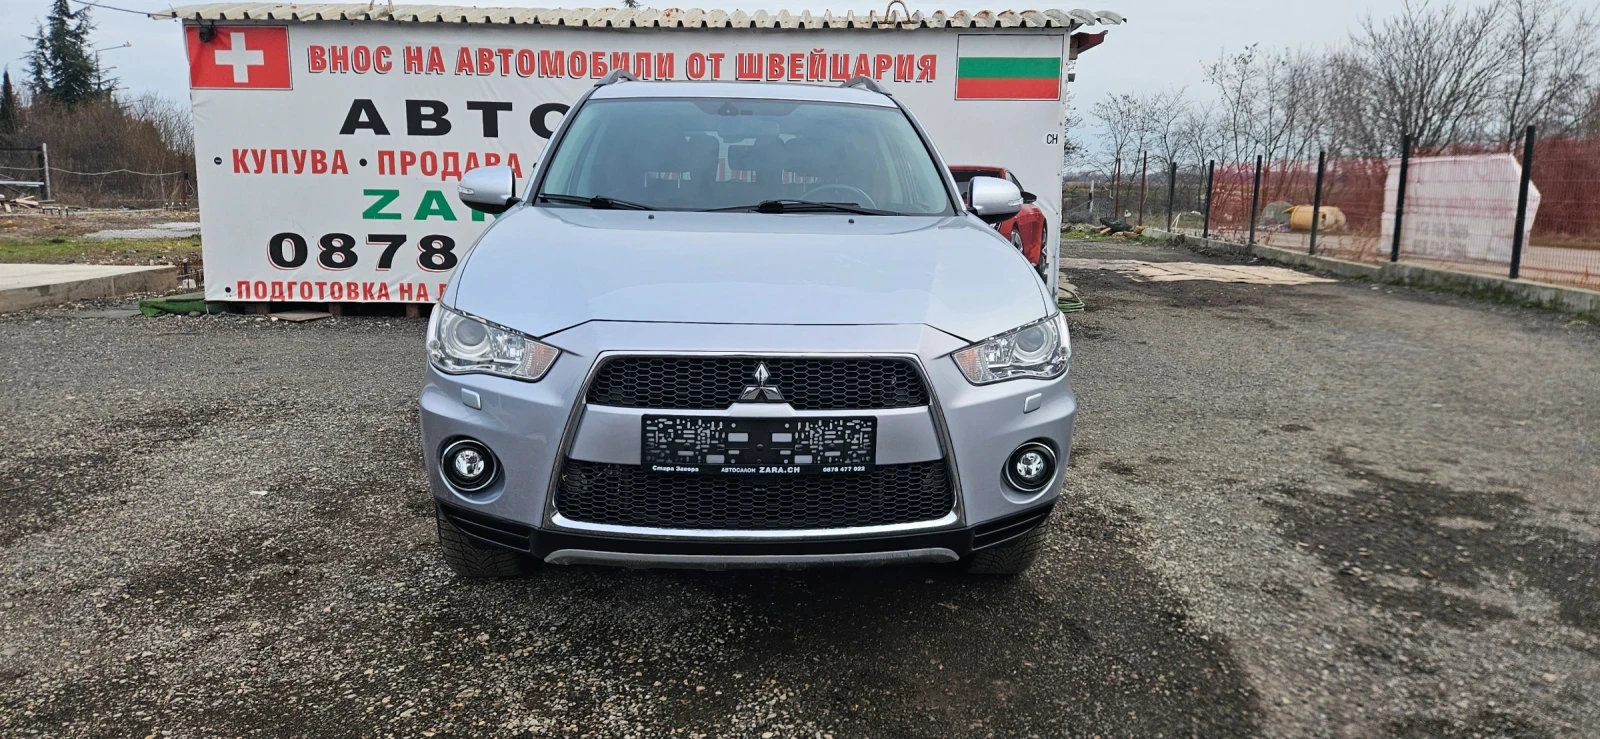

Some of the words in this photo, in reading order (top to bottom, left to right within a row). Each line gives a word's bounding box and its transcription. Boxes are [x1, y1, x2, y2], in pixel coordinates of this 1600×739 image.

[308, 45, 393, 74] ВНОС
[403, 46, 446, 75] НА
[455, 47, 674, 80] АВТОМОБИЛИ
[686, 52, 725, 81] ОТ
[735, 48, 937, 83] ШВЕЙЦАРИЯ
[1046, 133, 1058, 144] CH
[232, 149, 349, 174] КУПУВА
[362, 189, 500, 221] ZA
[267, 232, 458, 273] 0878
[237, 281, 390, 302] ПОДГОТОВКА
[399, 282, 429, 302] НА
[759, 466, 801, 474] ZARA.CH
